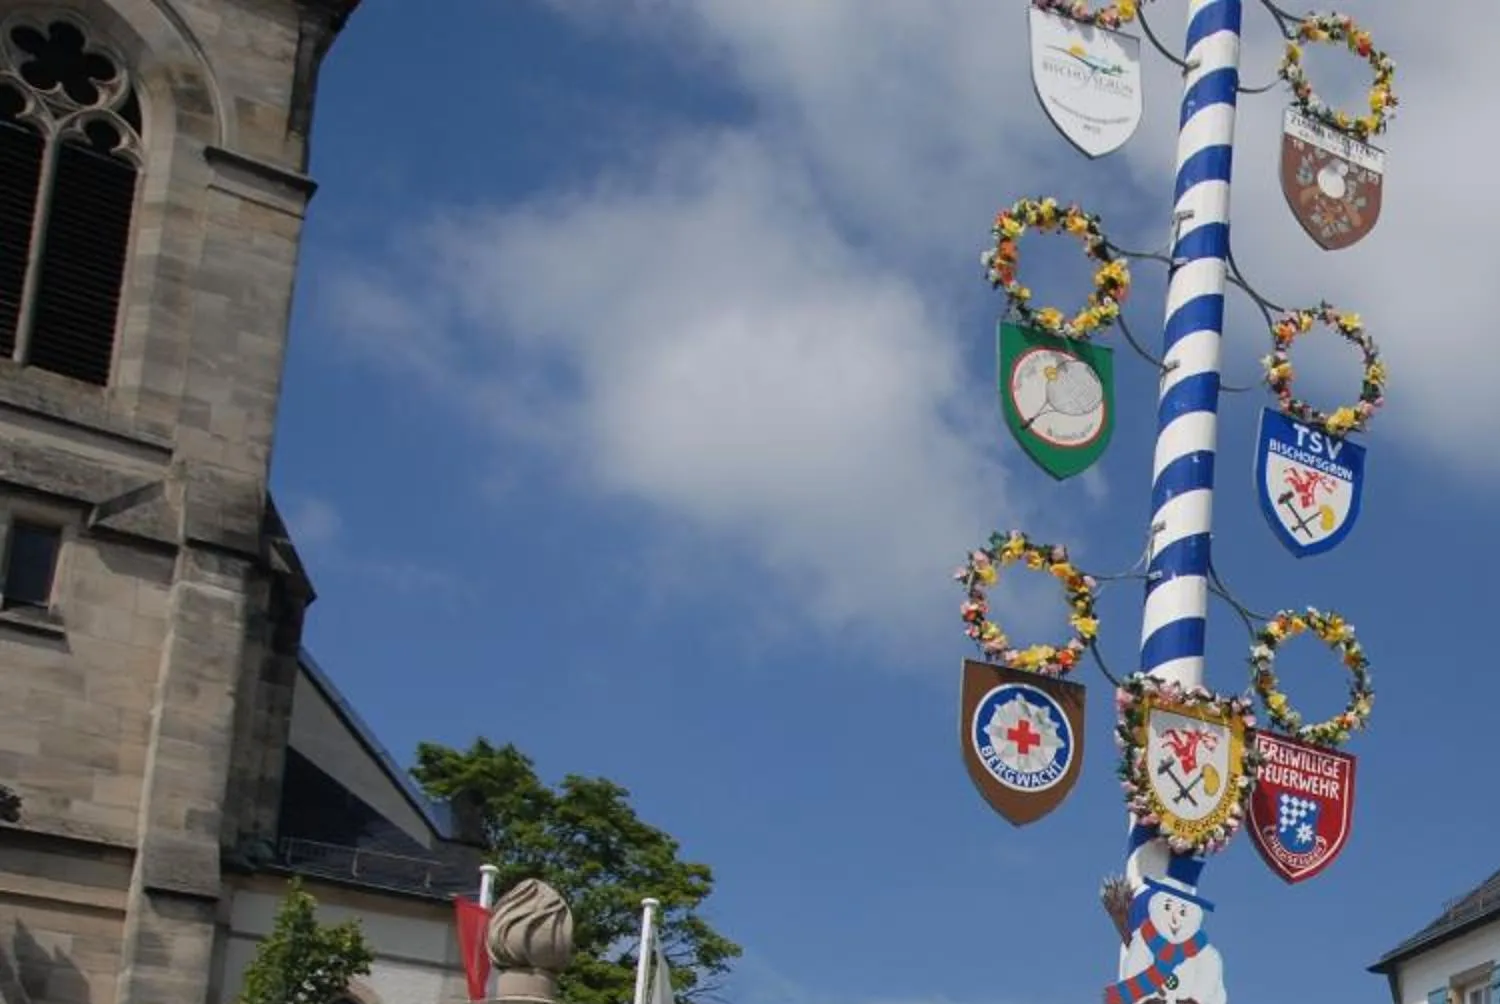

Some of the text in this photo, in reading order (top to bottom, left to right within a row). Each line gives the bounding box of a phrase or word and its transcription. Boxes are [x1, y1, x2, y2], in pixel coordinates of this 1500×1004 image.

[1293, 422, 1343, 460] TSV
[981, 744, 1064, 788] BERGWACHT
[1259, 739, 1341, 779] FREIWILLIGE
[1257, 765, 1341, 800] FEUERWEHR
